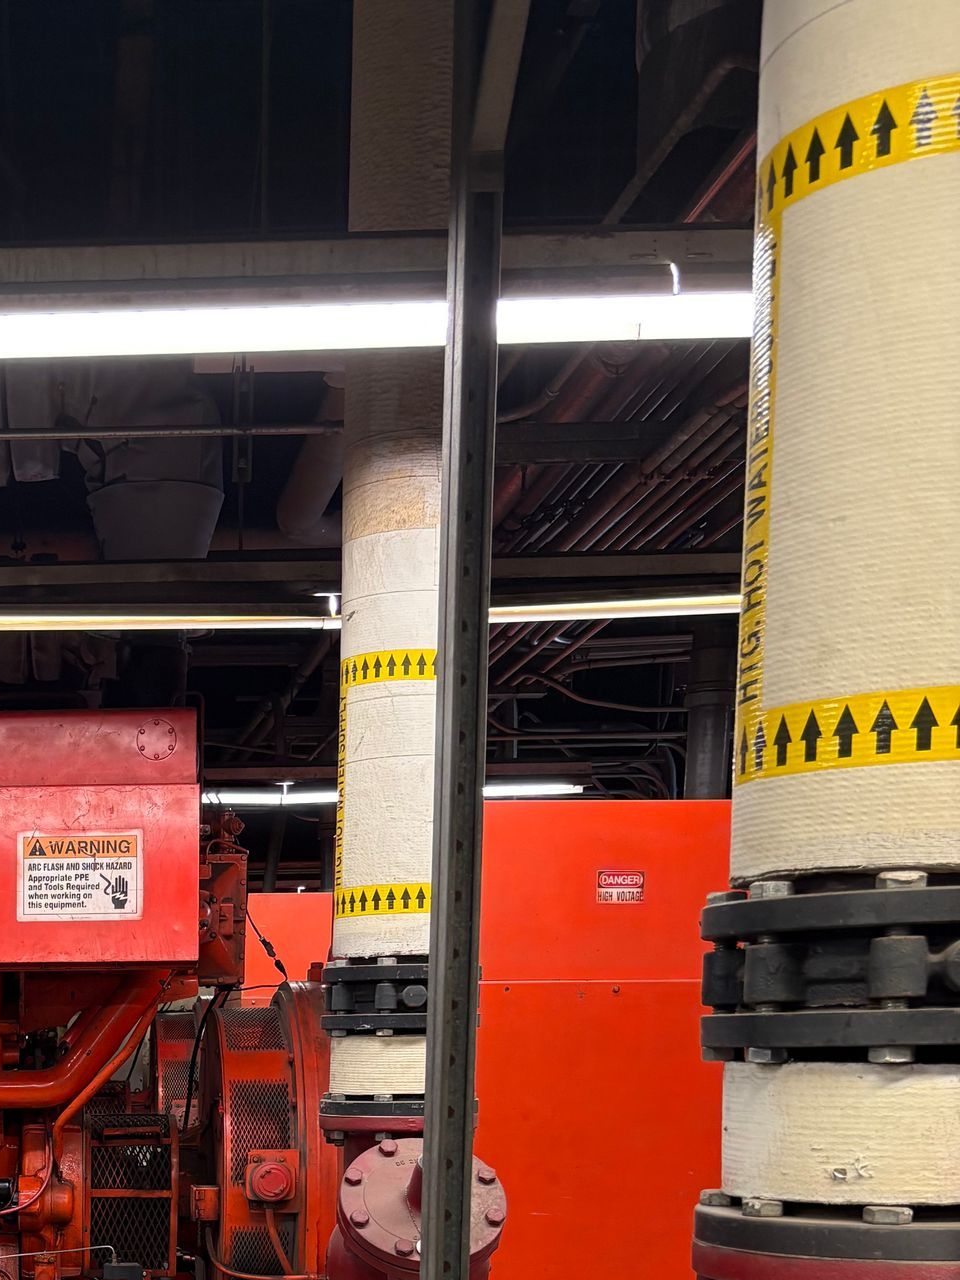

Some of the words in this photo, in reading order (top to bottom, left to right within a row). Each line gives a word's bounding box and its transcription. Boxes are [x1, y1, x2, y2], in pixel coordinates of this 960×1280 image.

[746, 388, 771, 531] WATER
[741, 540, 764, 614] HOT
[738, 620, 761, 707] HTG.
[49, 840, 131, 855] WARNING
[28, 863, 41, 871] ARC
[43, 863, 64, 871] FLASH
[66, 863, 80, 871] AND
[81, 862, 104, 871] SHOCK
[105, 861, 133, 870] HAZARD
[28, 874, 73, 884] Appropriate
[74, 873, 90, 881] PPE
[602, 876, 640, 884] DANGER
[28, 883, 42, 891] and
[66, 882, 100, 892] Required
[28, 892, 49, 900] when
[50, 891, 81, 901] working
[598, 890, 612, 902] HIGH
[616, 890, 644, 902] VOLTAGE
[28, 901, 42, 909] this
[44, 900, 87, 910] equipment.
